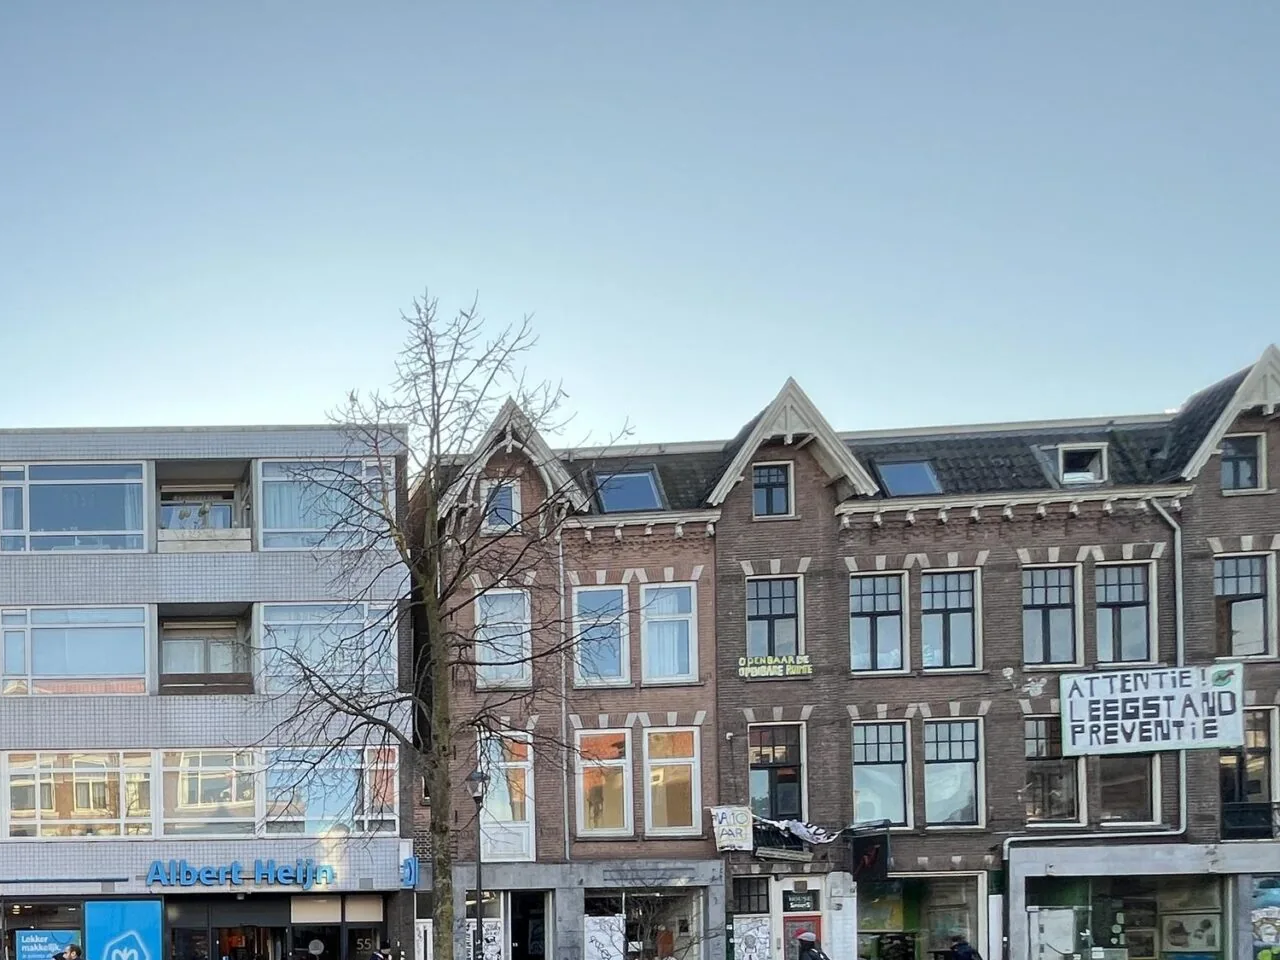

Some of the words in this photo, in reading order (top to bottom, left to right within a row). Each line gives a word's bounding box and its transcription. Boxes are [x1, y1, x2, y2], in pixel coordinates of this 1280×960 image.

[1070, 690, 1237, 723] LEEGSTAND
[146, 859, 242, 887] Albert
[254, 858, 335, 890] Heijn
[21, 935, 49, 943] Lekker
[356, 938, 372, 950] 55
